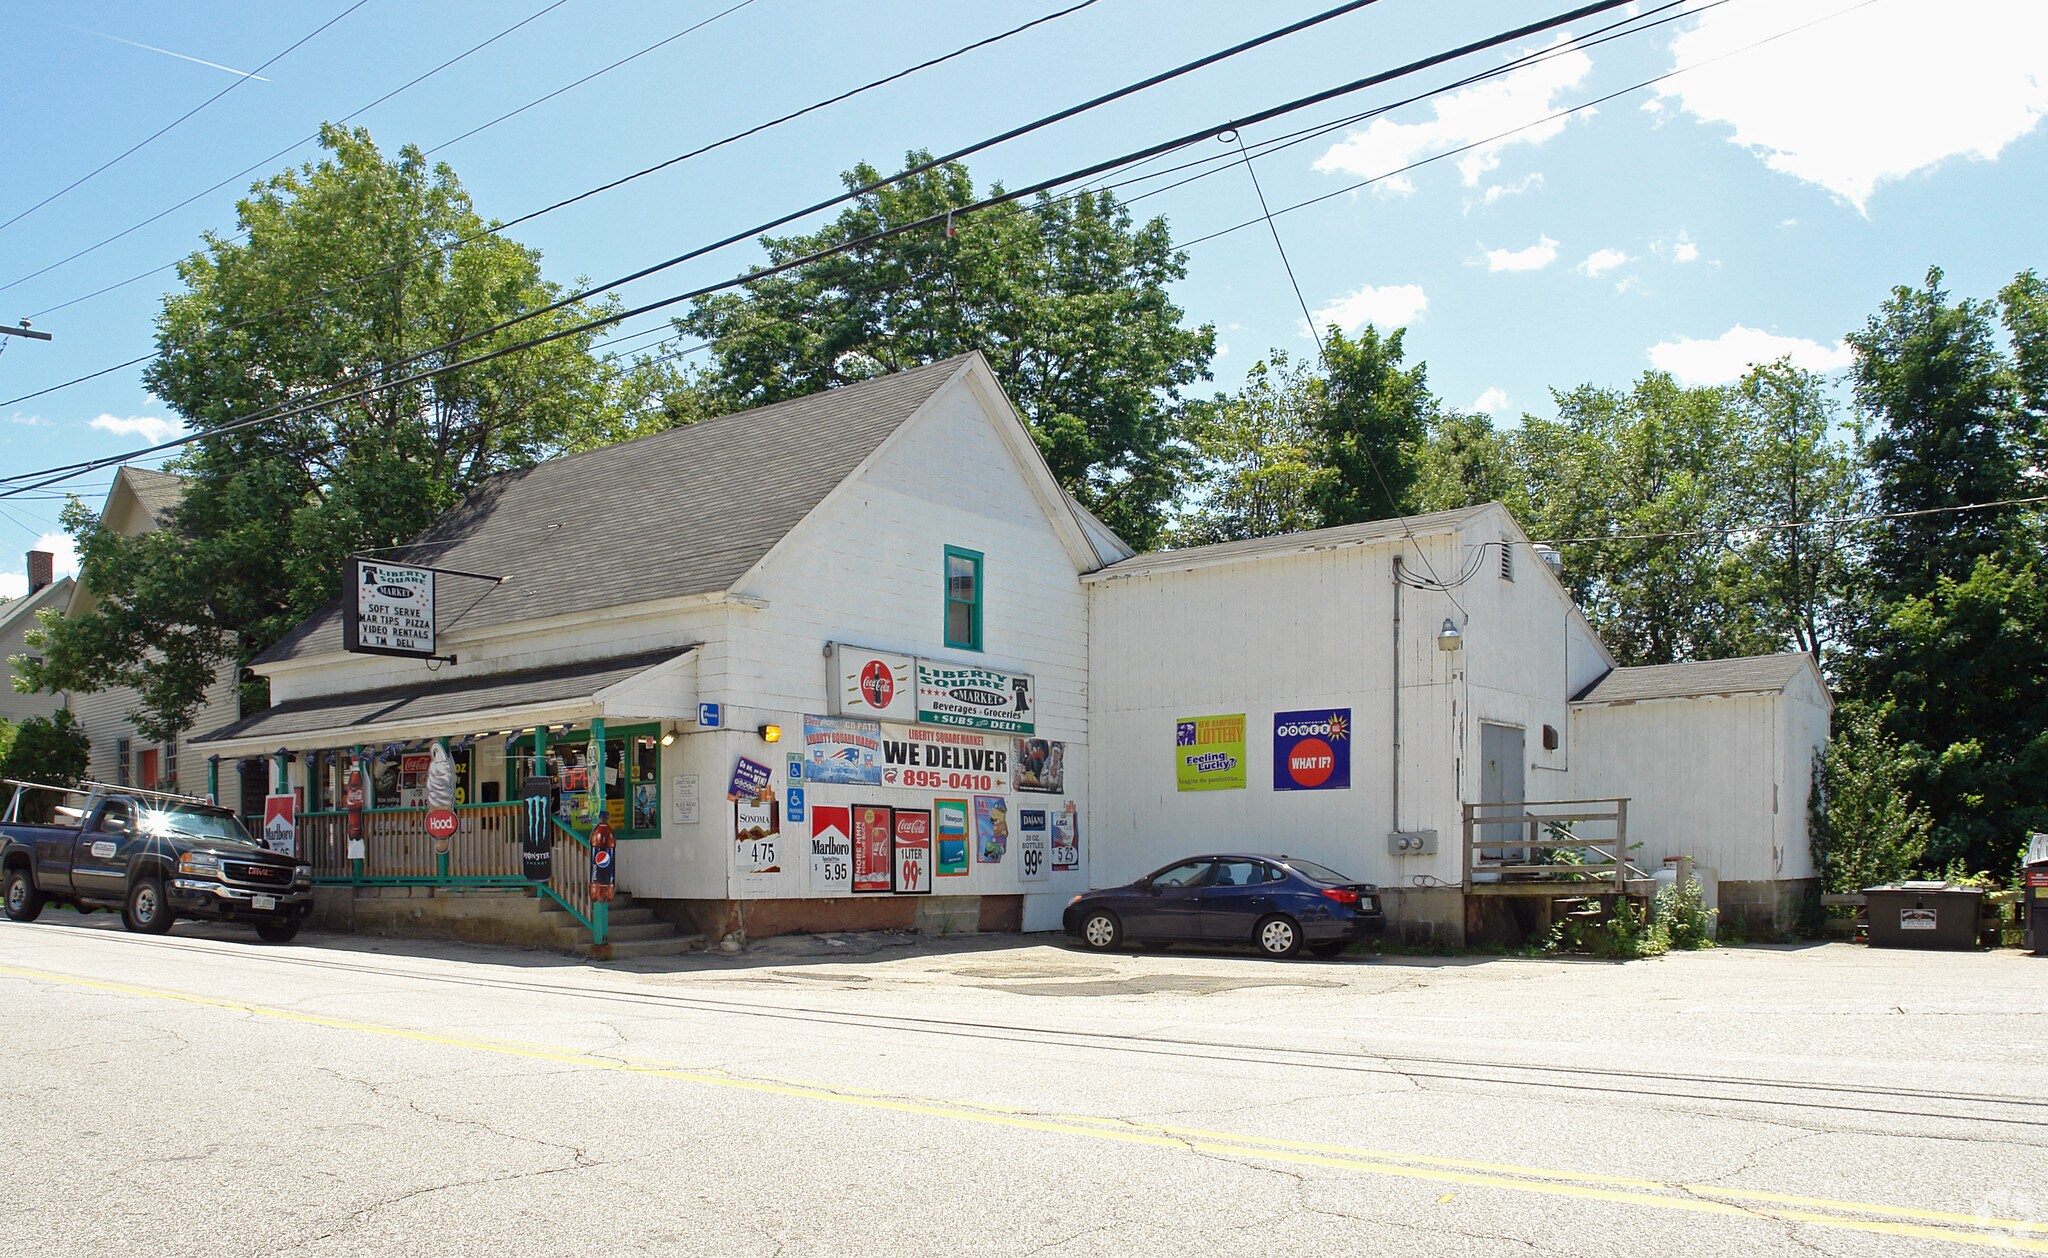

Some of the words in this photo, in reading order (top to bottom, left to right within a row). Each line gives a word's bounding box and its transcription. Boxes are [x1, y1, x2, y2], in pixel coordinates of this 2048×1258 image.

[379, 568, 427, 579] LIBERTY
[380, 576, 426, 586] SQUARE
[380, 587, 411, 597] MARKET
[369, 604, 389, 614] SOFT
[394, 607, 420, 617] SERVE
[381, 616, 399, 626] TIPS
[406, 619, 430, 629] PIZZA
[363, 624, 387, 635] VIDEO
[393, 628, 429, 639] RENTALS
[397, 639, 415, 648] DELI
[918, 665, 1007, 682] LIBERTY
[920, 677, 1005, 691] SQUARE
[959, 689, 1000, 704] MARKET
[933, 702, 977, 715] Beverages
[984, 708, 1021, 719] Groceries
[845, 721, 856, 729] GO
[857, 723, 879, 732] PATS!
[941, 715, 974, 726] SUBS
[990, 720, 1016, 730] DELI
[1198, 720, 1210, 728] NEW
[1212, 718, 1243, 727] HAMPSHIRE
[909, 728, 934, 741] LIBERTY
[1198, 726, 1244, 744] LOTTERY
[806, 732, 831, 745] LIBERTY
[832, 732, 854, 744] SQUARE
[856, 735, 879, 751] MARKET
[883, 740, 919, 766] WE
[926, 744, 1007, 773] DELIVER
[1186, 752, 1226, 765] Feeling
[1292, 757, 1317, 769] WHAT
[1319, 756, 1331, 768] IF?
[1198, 758, 1235, 771] Lucky?
[753, 773, 767, 786] WIN!
[903, 769, 991, 791] 895-0410
[740, 814, 770, 824] SONOMA
[945, 813, 963, 823] Newport
[1023, 815, 1044, 826] DASANI
[1056, 819, 1067, 827] USA
[266, 824, 293, 841] Marlboro
[898, 819, 926, 834] Coca-Cola
[812, 836, 850, 855] Marlboro
[524, 851, 550, 861] MONSTER
[248, 867, 274, 876] GMC
[825, 864, 847, 881] 5.95
